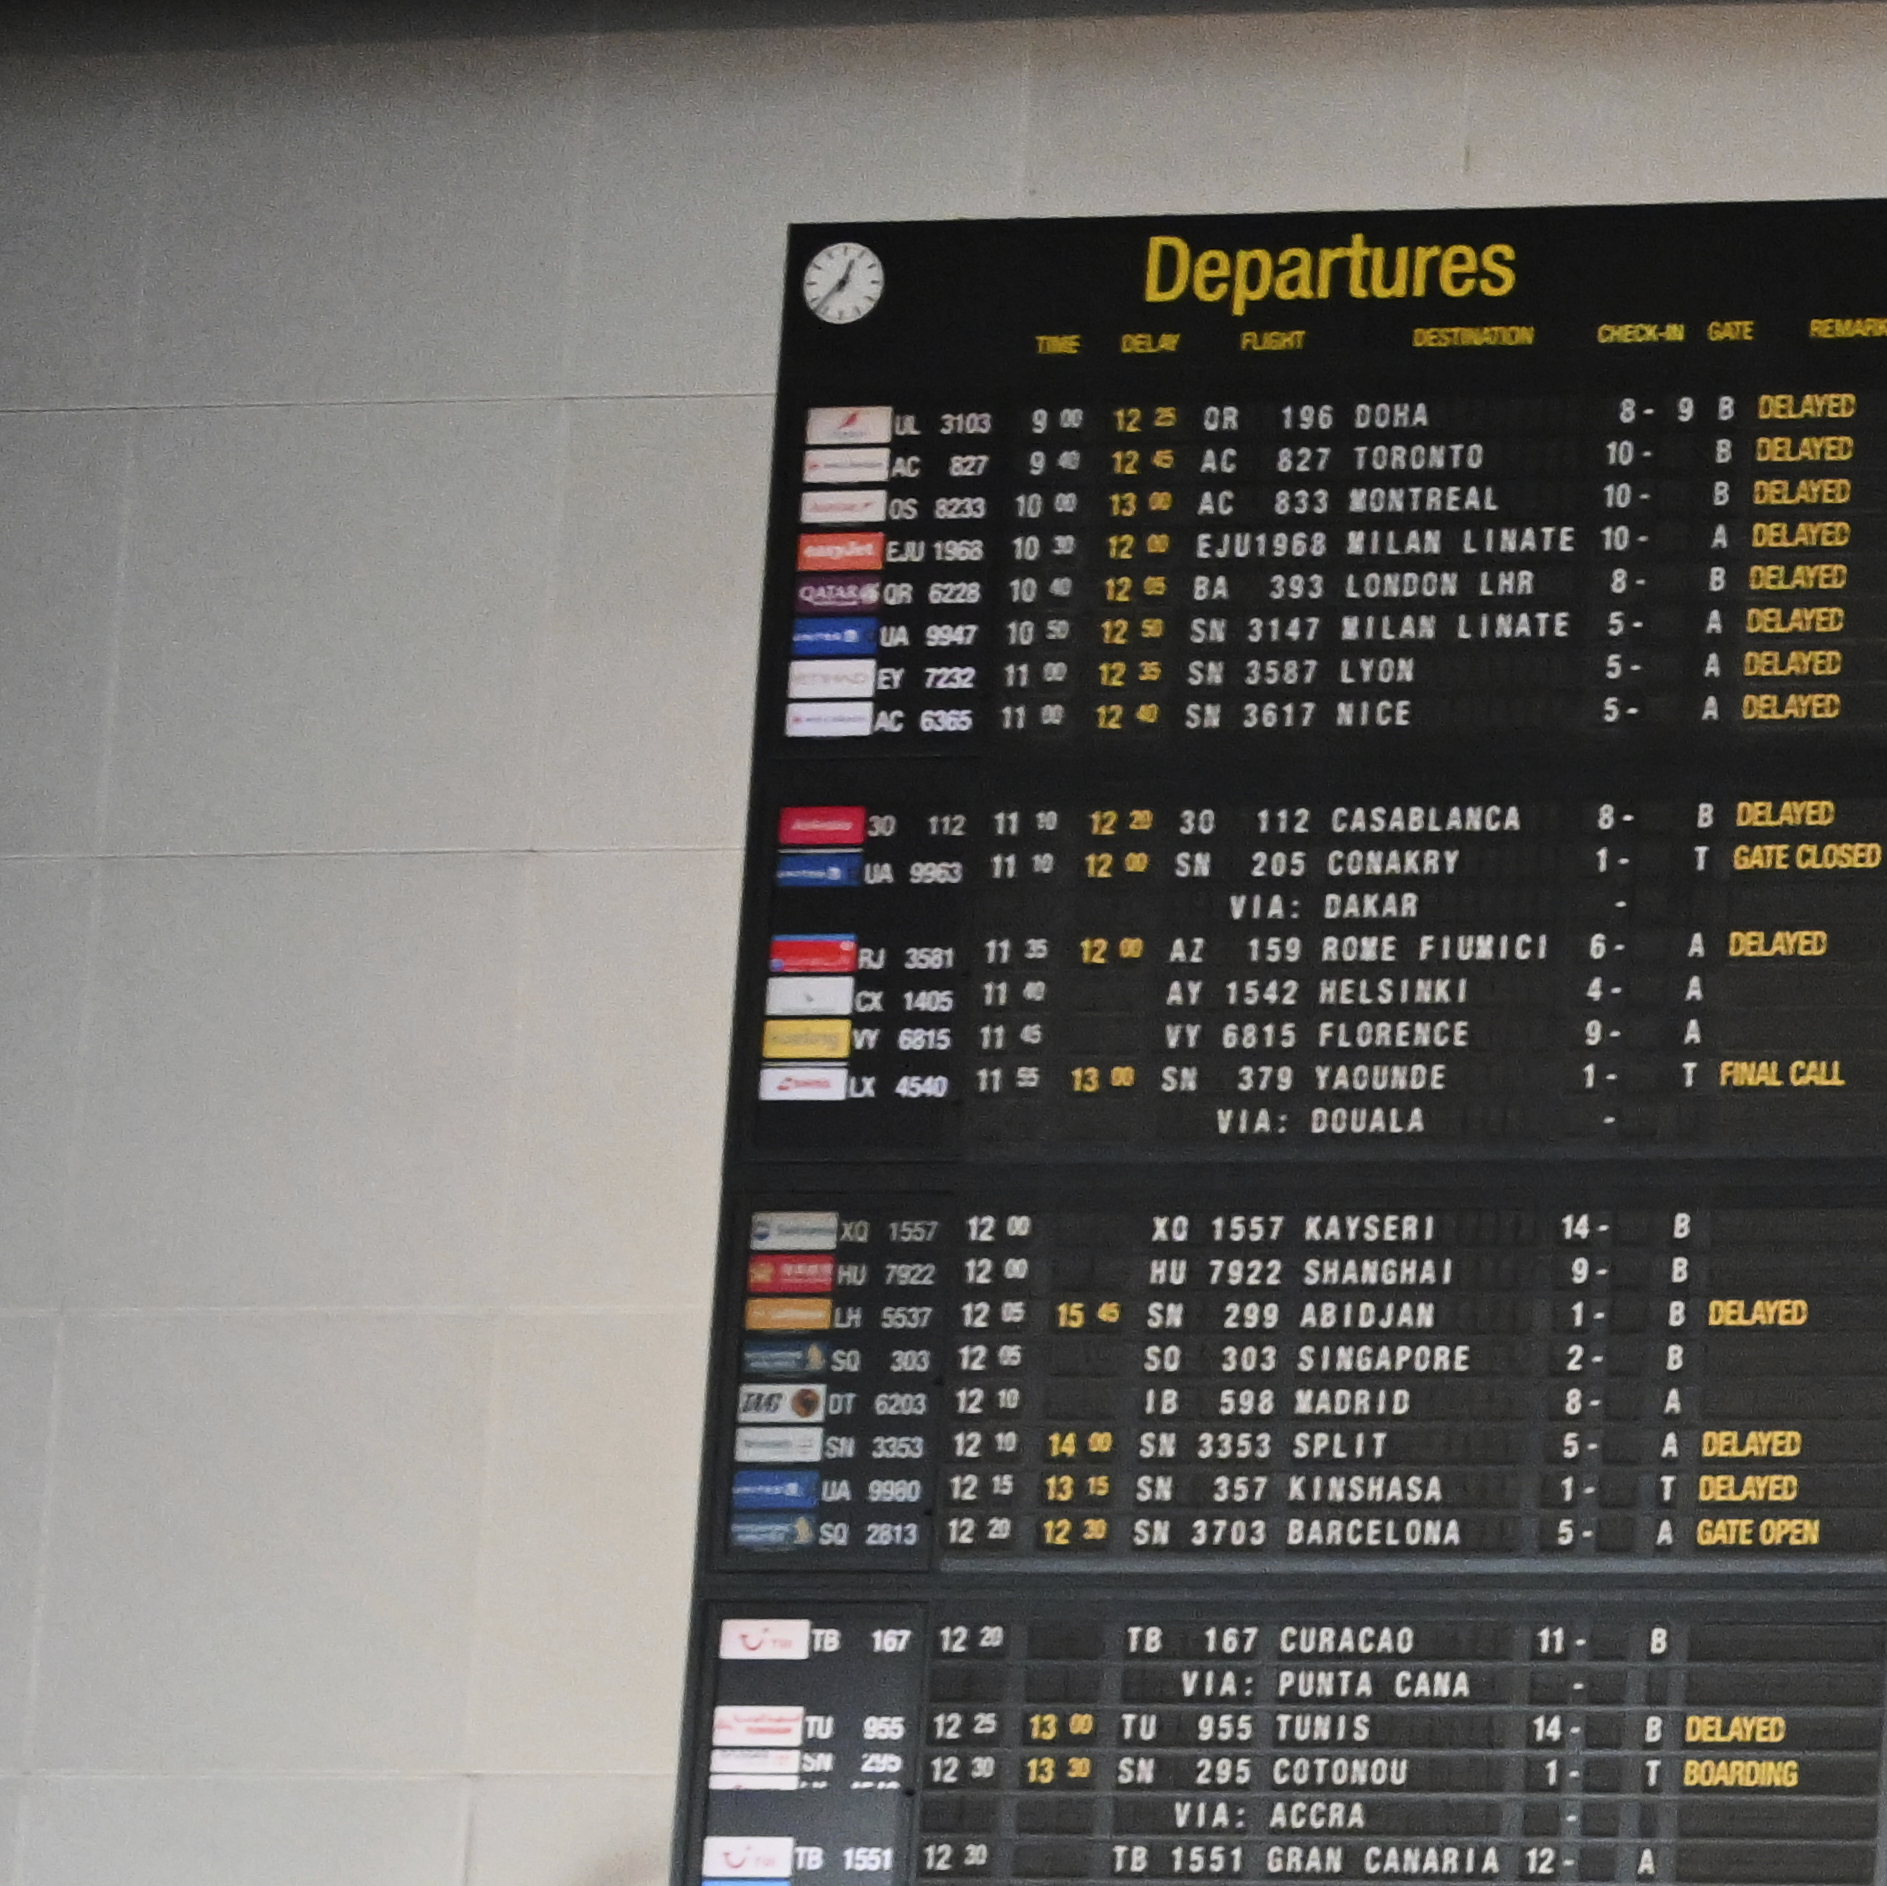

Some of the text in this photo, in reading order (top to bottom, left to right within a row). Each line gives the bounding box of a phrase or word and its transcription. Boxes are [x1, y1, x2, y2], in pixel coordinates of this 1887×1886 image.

[1145, 234, 1515, 316] Departures
[1355, 393, 1856, 428] DOHA DELAYED
[1355, 444, 1483, 470] TORONTO
[1349, 479, 1851, 512] MONTREAL DELAYED
[1347, 527, 1574, 554] MILAN LINATE
[1346, 572, 1457, 598] LONDON
[1332, 801, 1834, 832] CASABLANCA DELAYED
[1328, 843, 1882, 875] CONAKRY GATE CLOSED
[1319, 1021, 1468, 1047] FLORENCE
[1719, 1058, 1845, 1089] FINAL CALL
[1304, 1259, 1451, 1285] SHANGHAI
[1301, 1299, 1807, 1328] ABIDJAN DELAYED
[1298, 1345, 1469, 1371] SINGAPORE
[1294, 1432, 1386, 1458] SPLIT
[1289, 1475, 1797, 1502] KINSHASA DELAYED
[1288, 1519, 1819, 1545] BARCELONA GATE OPEN
[1281, 1627, 1413, 1653] CURACAO
[1277, 1714, 1785, 1742] TUNIS DELAYED
[1274, 1758, 1798, 1787] COTONOU BOARDING
[1267, 1846, 1499, 1873] GRAN CANARIA
